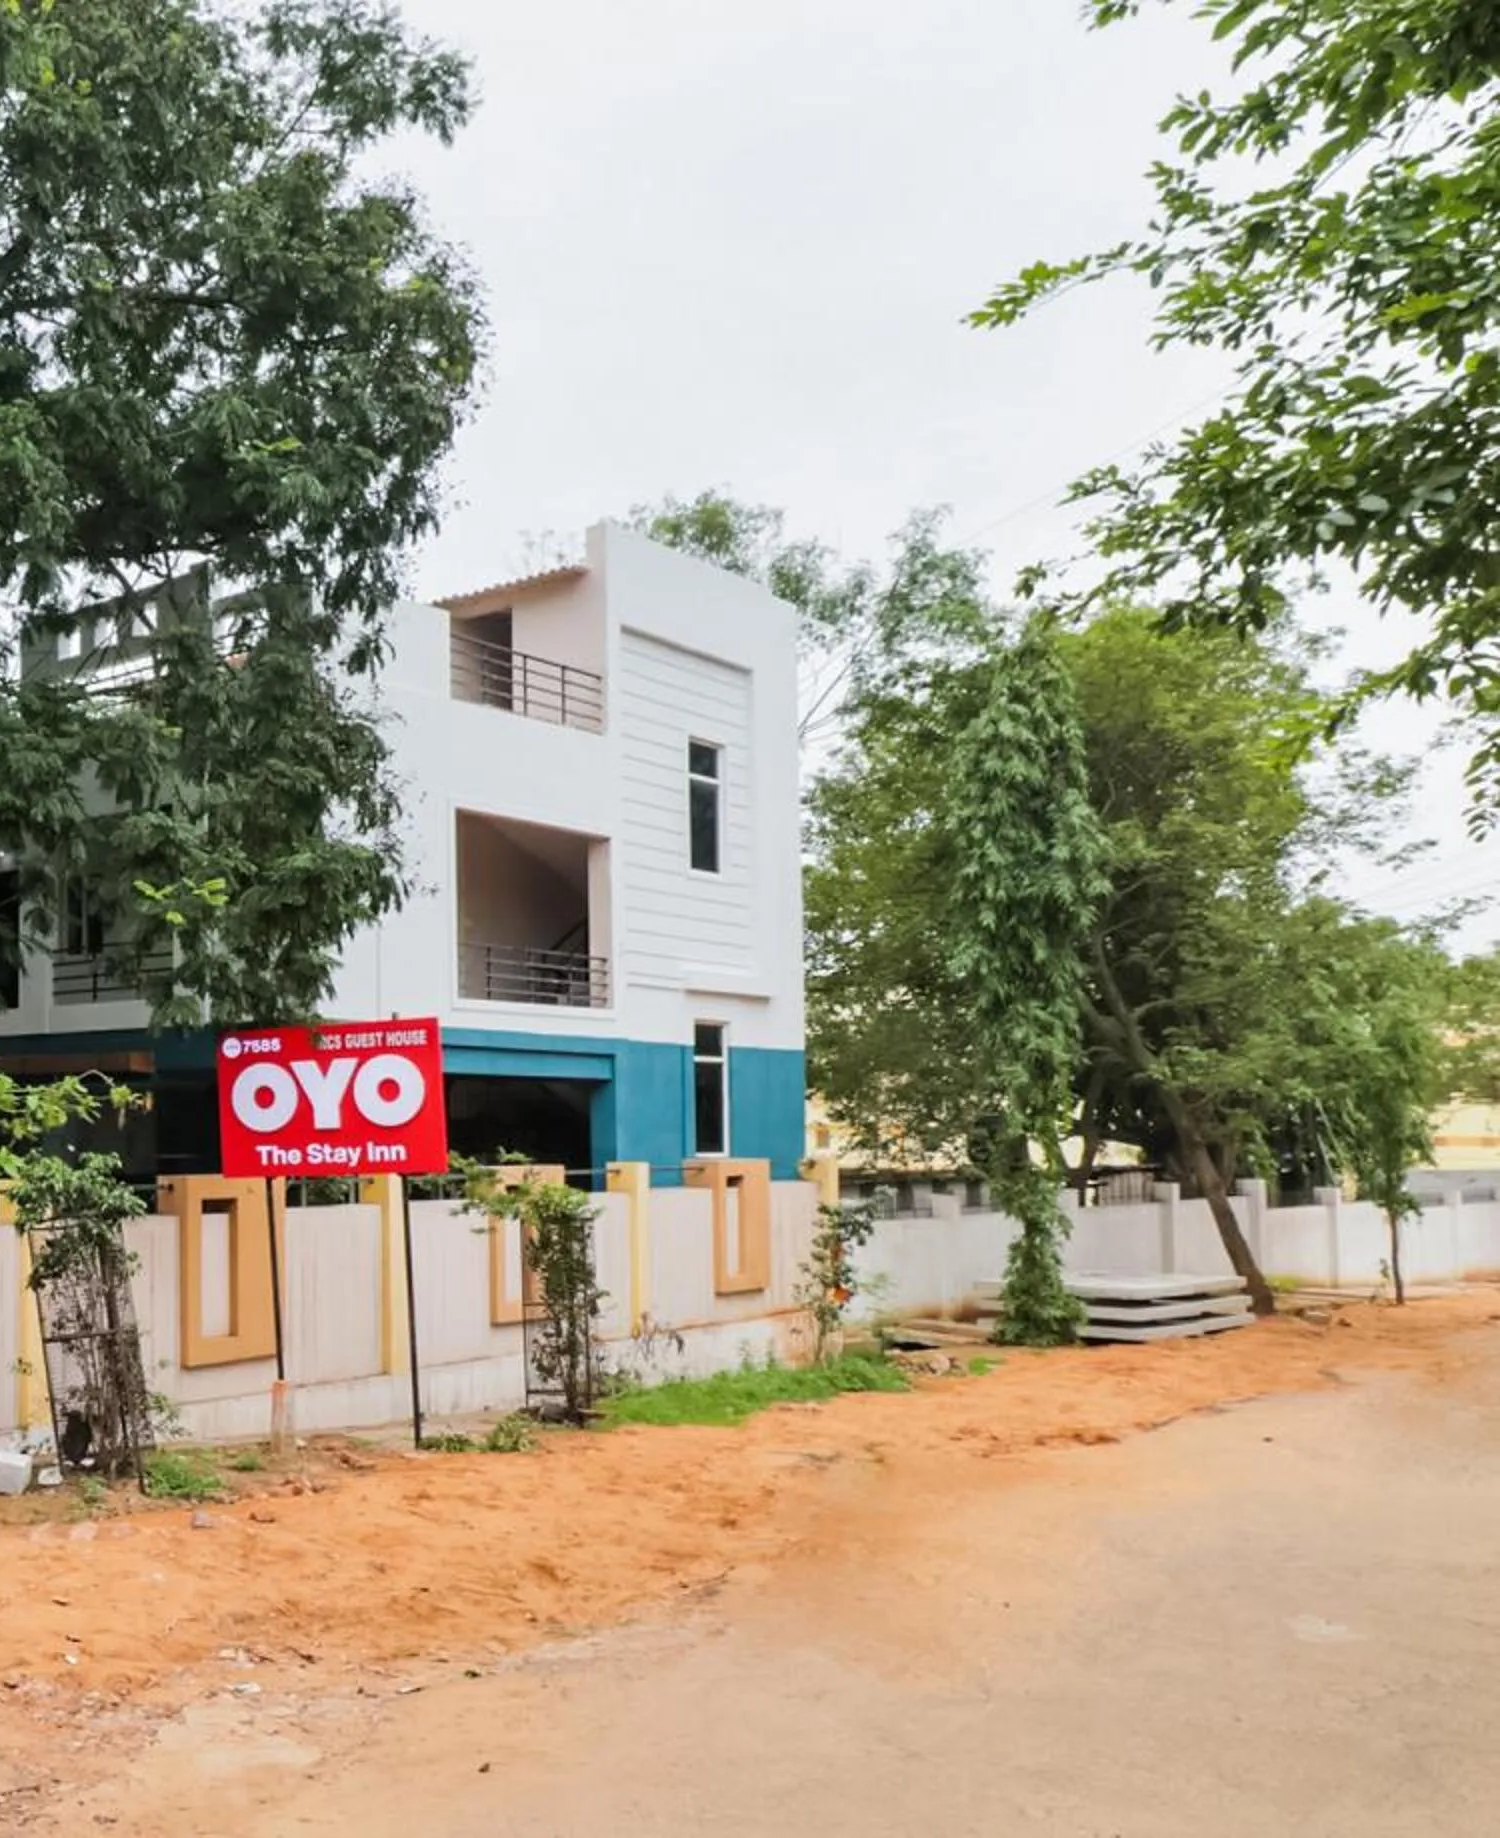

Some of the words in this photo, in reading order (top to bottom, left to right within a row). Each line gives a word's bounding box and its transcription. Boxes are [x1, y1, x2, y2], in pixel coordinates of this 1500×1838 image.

[345, 1032, 384, 1049] GUEST
[386, 1029, 427, 1047] HOUSE
[231, 1053, 426, 1133] OYO
[255, 1144, 303, 1166] The
[306, 1142, 362, 1168] Stay
[366, 1141, 407, 1162] Inn
